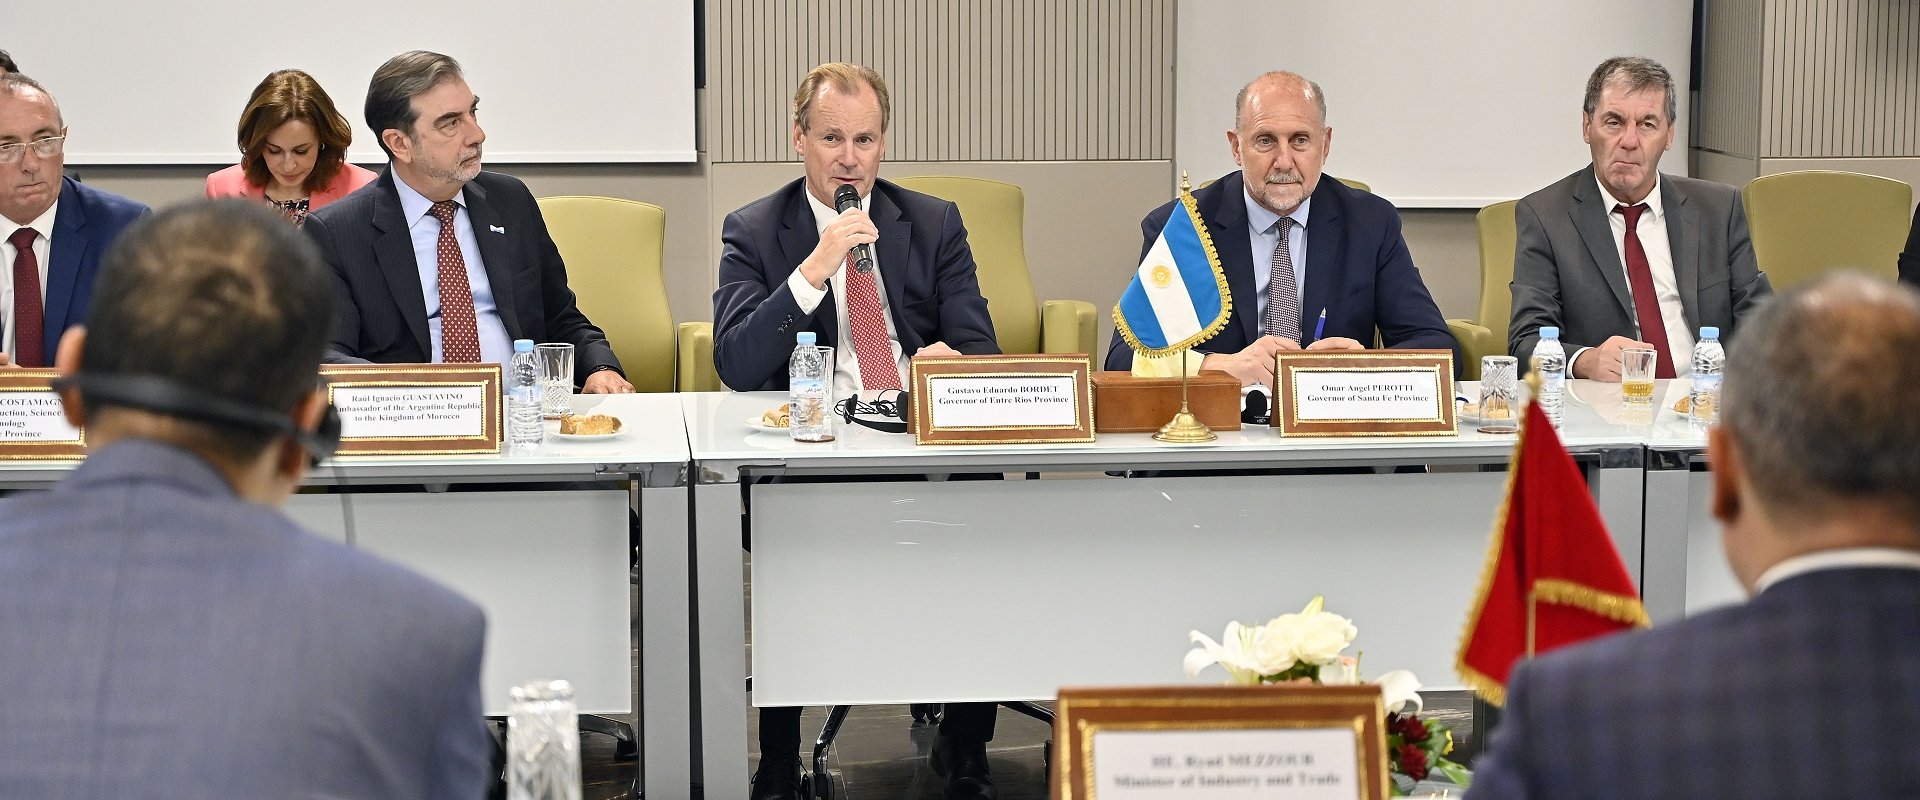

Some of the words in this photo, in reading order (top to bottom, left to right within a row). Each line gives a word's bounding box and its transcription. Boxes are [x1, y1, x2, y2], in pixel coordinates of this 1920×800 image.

[947, 387, 981, 395] Gustavo
[983, 386, 1018, 394] Eduardo
[1020, 385, 1059, 393] BORDET
[1321, 384, 1346, 392] Omar
[1347, 384, 1371, 393] Angel
[372, 394, 401, 403] Ignacio
[402, 393, 463, 401] GUASTAVINO
[938, 397, 978, 405] Governor
[979, 396, 989, 404] of
[990, 396, 1013, 404] Entre
[1034, 395, 1069, 403] Province
[1307, 394, 1346, 402] Governor
[1347, 394, 1357, 402] of
[1357, 394, 1381, 402] Santa
[1382, 394, 1392, 402] Fe
[1394, 394, 1429, 402] Province
[408, 403, 446, 412] Argentine
[447, 402, 482, 411] Republic
[379, 413, 415, 422] Kingdom
[416, 412, 425, 420] of
[426, 412, 460, 420] Morocco
